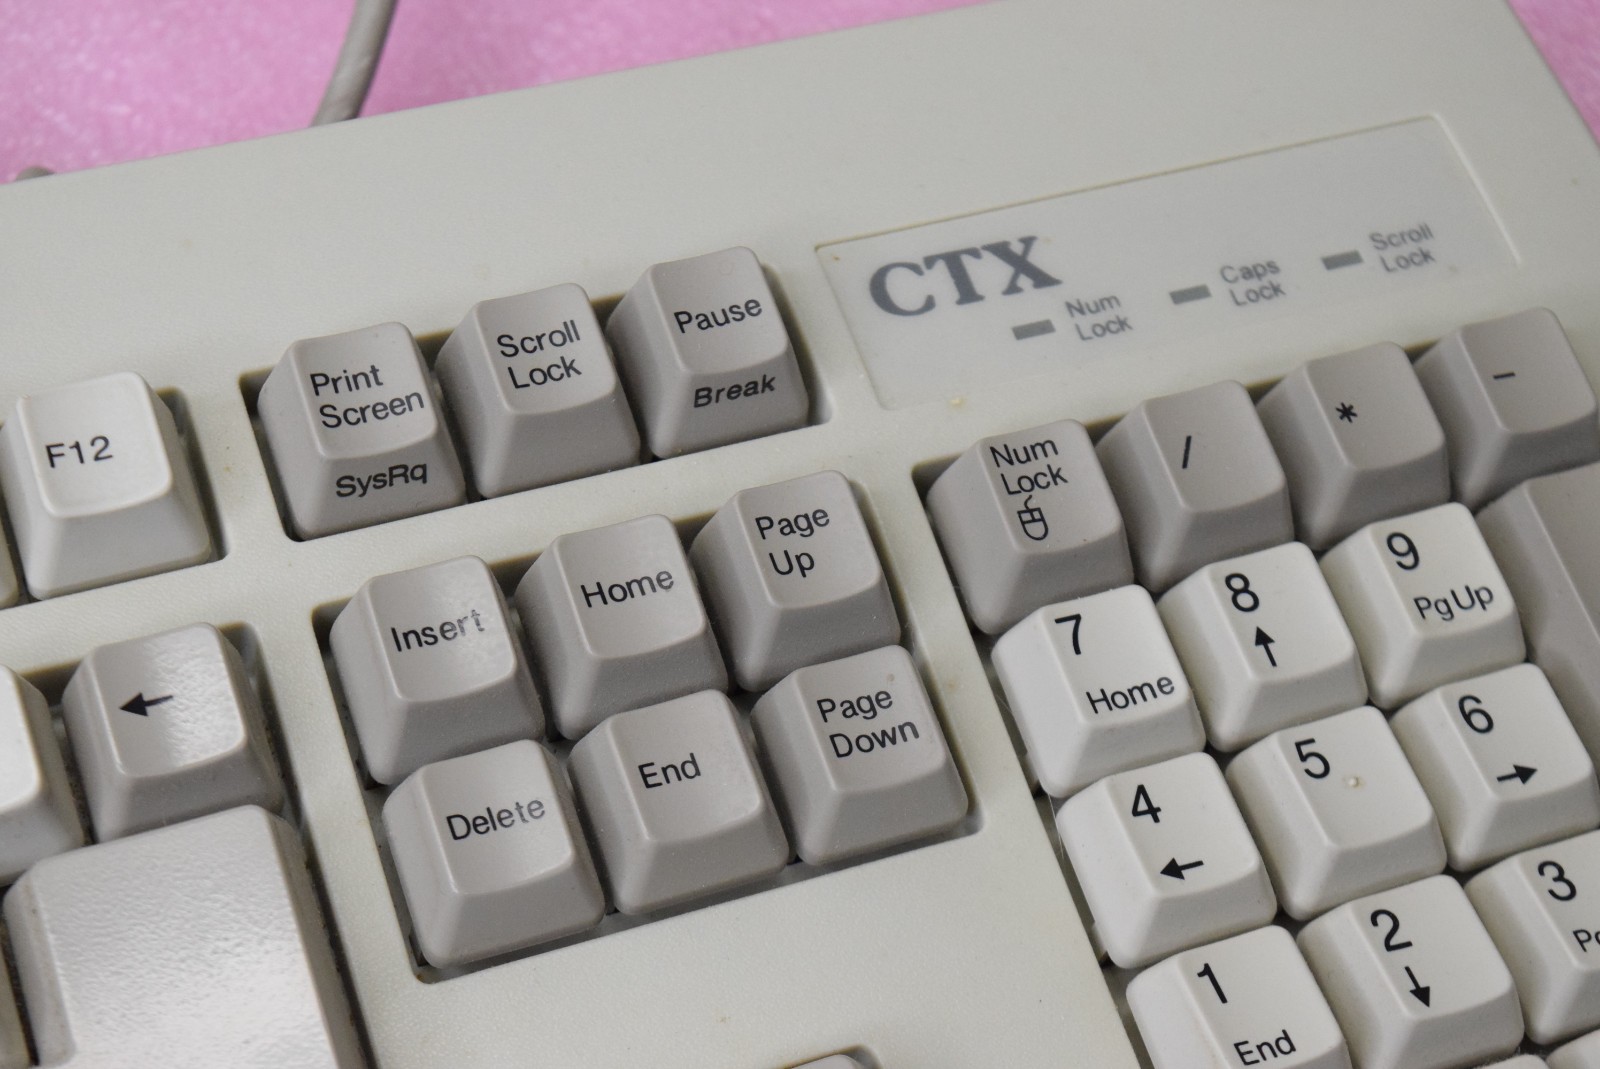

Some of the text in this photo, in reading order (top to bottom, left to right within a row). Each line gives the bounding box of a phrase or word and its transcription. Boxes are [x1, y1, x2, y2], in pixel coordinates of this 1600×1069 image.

[1370, 223, 1434, 251] Scroll
[869, 236, 1062, 317] CTX
[1220, 259, 1281, 284] Caps
[1379, 247, 1435, 273] Lock
[1065, 293, 1121, 318] Num
[1230, 280, 1286, 306] Lock
[674, 300, 762, 333] Pause
[1074, 315, 1133, 341] Lock
[497, 320, 581, 358] Scroll
[310, 365, 383, 396] Print
[508, 355, 583, 389] Lock
[318, 387, 425, 429] Screen
[694, 374, 775, 408] Break
[46, 436, 113, 468] F12
[990, 437, 1059, 468] Num
[336, 464, 427, 497] SysRq
[1003, 463, 1068, 496] Lock
[755, 509, 829, 540] Page
[769, 550, 814, 578] Up
[1387, 532, 1419, 570] 9
[581, 571, 674, 608] Home
[1225, 573, 1259, 612] 8
[391, 610, 484, 652] Insert
[1055, 614, 1081, 655] 7
[817, 691, 892, 723] Page
[1086, 677, 1174, 714] Home
[1458, 695, 1494, 734] 6
[829, 719, 919, 759] Down
[638, 753, 701, 789] End
[1295, 738, 1330, 779] 5
[446, 800, 545, 840] Delete
[1132, 784, 1161, 823] 4
[1538, 861, 1576, 901] 3
[1371, 909, 1412, 952] 2
[1197, 963, 1227, 1004] 1
[1234, 1029, 1296, 1065] End
